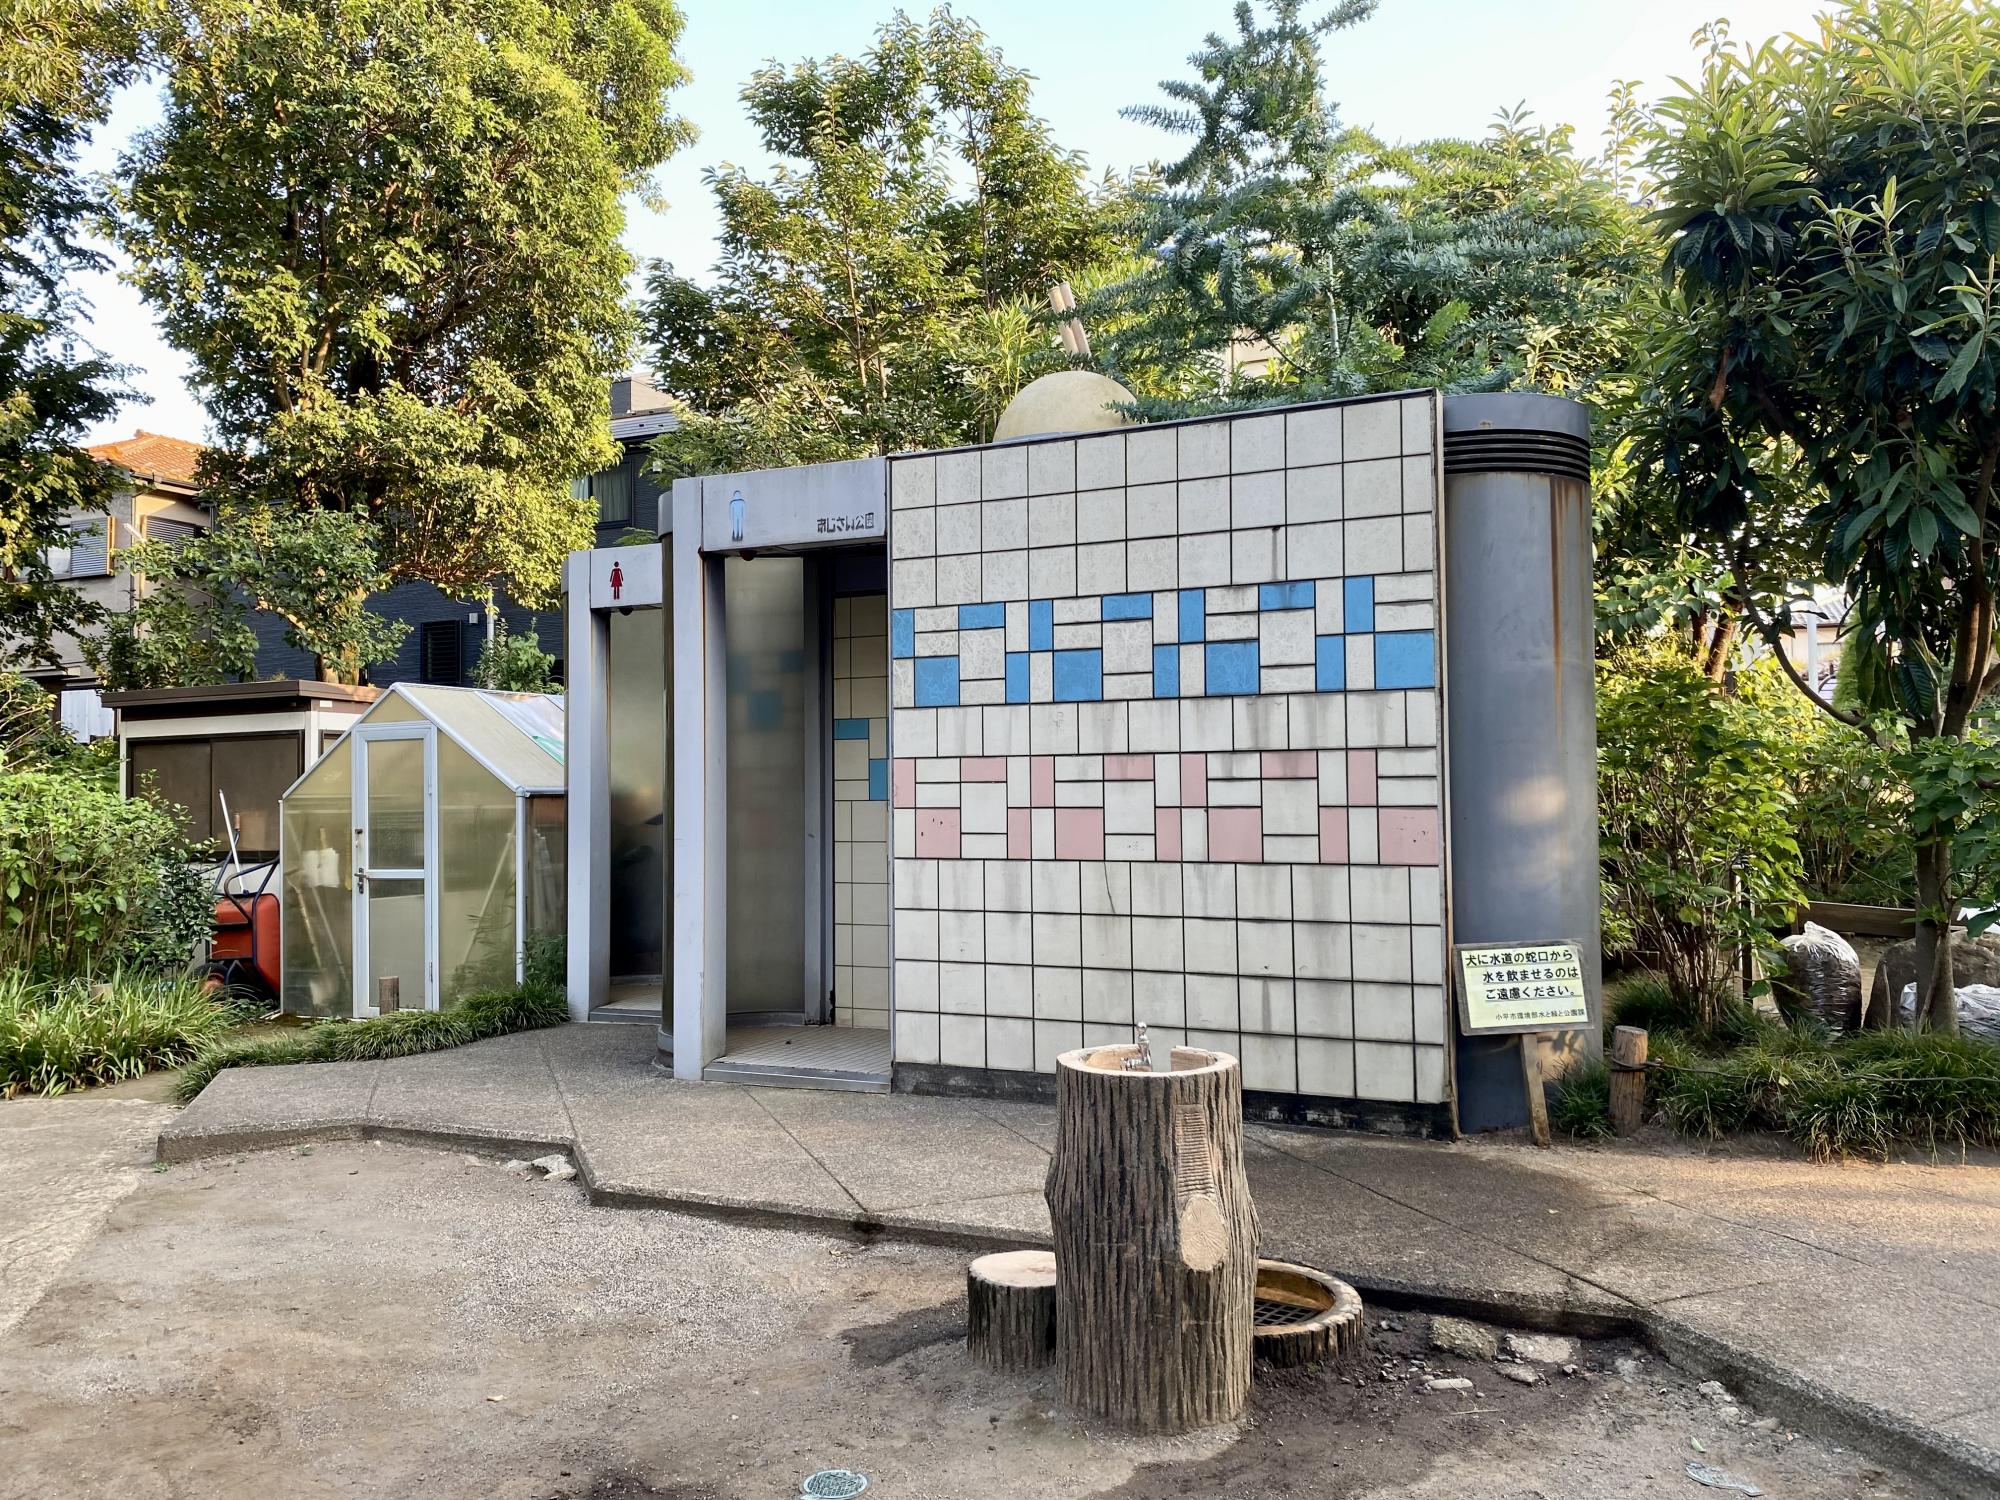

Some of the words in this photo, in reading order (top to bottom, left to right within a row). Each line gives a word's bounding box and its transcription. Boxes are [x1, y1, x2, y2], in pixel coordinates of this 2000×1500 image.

[1465, 950, 1573, 966] 犬に水道の蛇口から
[1482, 967, 1579, 982] 水を飲ませるのは
[1486, 986, 1575, 1000] ご遠慮ください。
